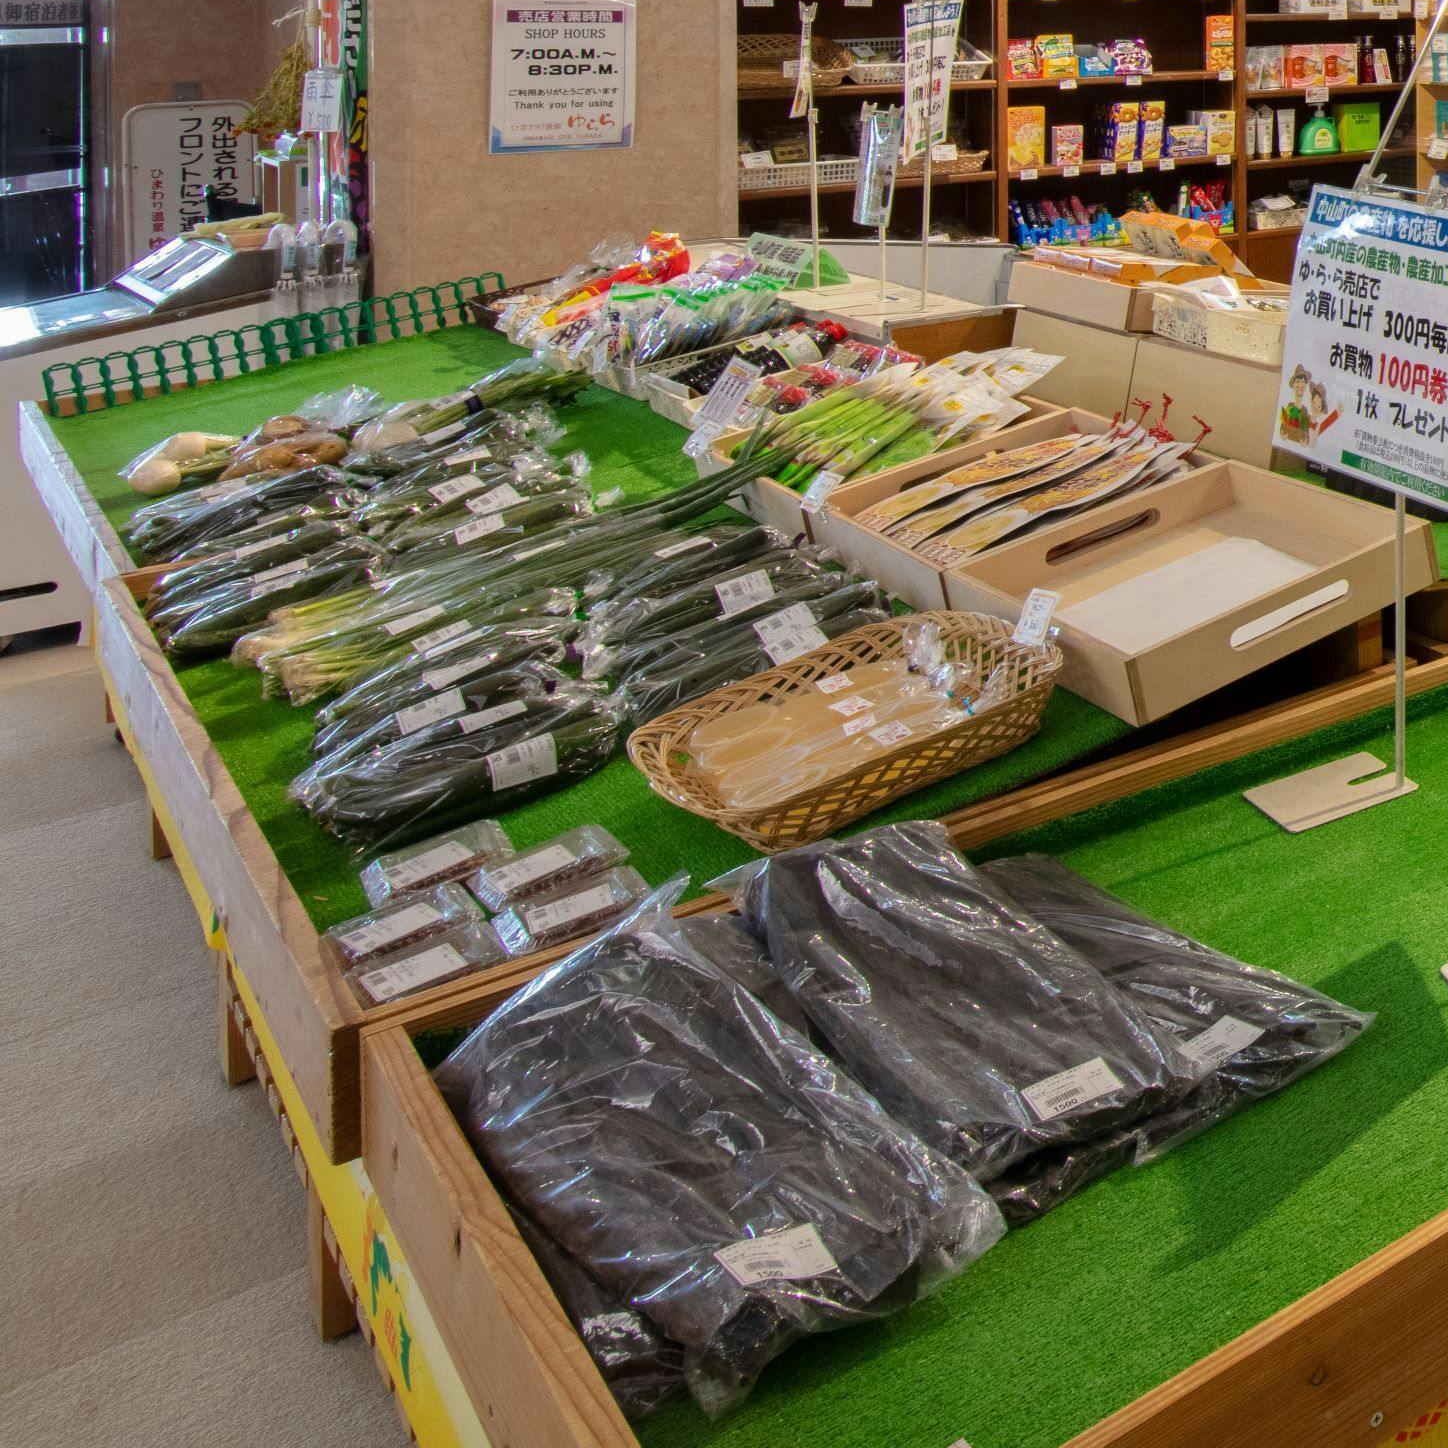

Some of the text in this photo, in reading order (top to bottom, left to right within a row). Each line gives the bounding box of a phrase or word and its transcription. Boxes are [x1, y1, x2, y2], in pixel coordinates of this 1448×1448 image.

[518, 10, 613, 23] 売店営業時間
[525, 29, 606, 39] SHOP HOURS
[528, 64, 618, 75] 8:30P.M.
[508, 87, 619, 97] ご利用ありがとうございます
[515, 100, 614, 110] Thank you for using
[150, 169, 165, 232] ひまわり温泉
[1303, 290, 1373, 333] お買い上げ
[1330, 342, 1448, 405] お買物 100円券
[1355, 388, 1378, 420] 1枚
[1052, 1097, 1078, 1112] 1500
